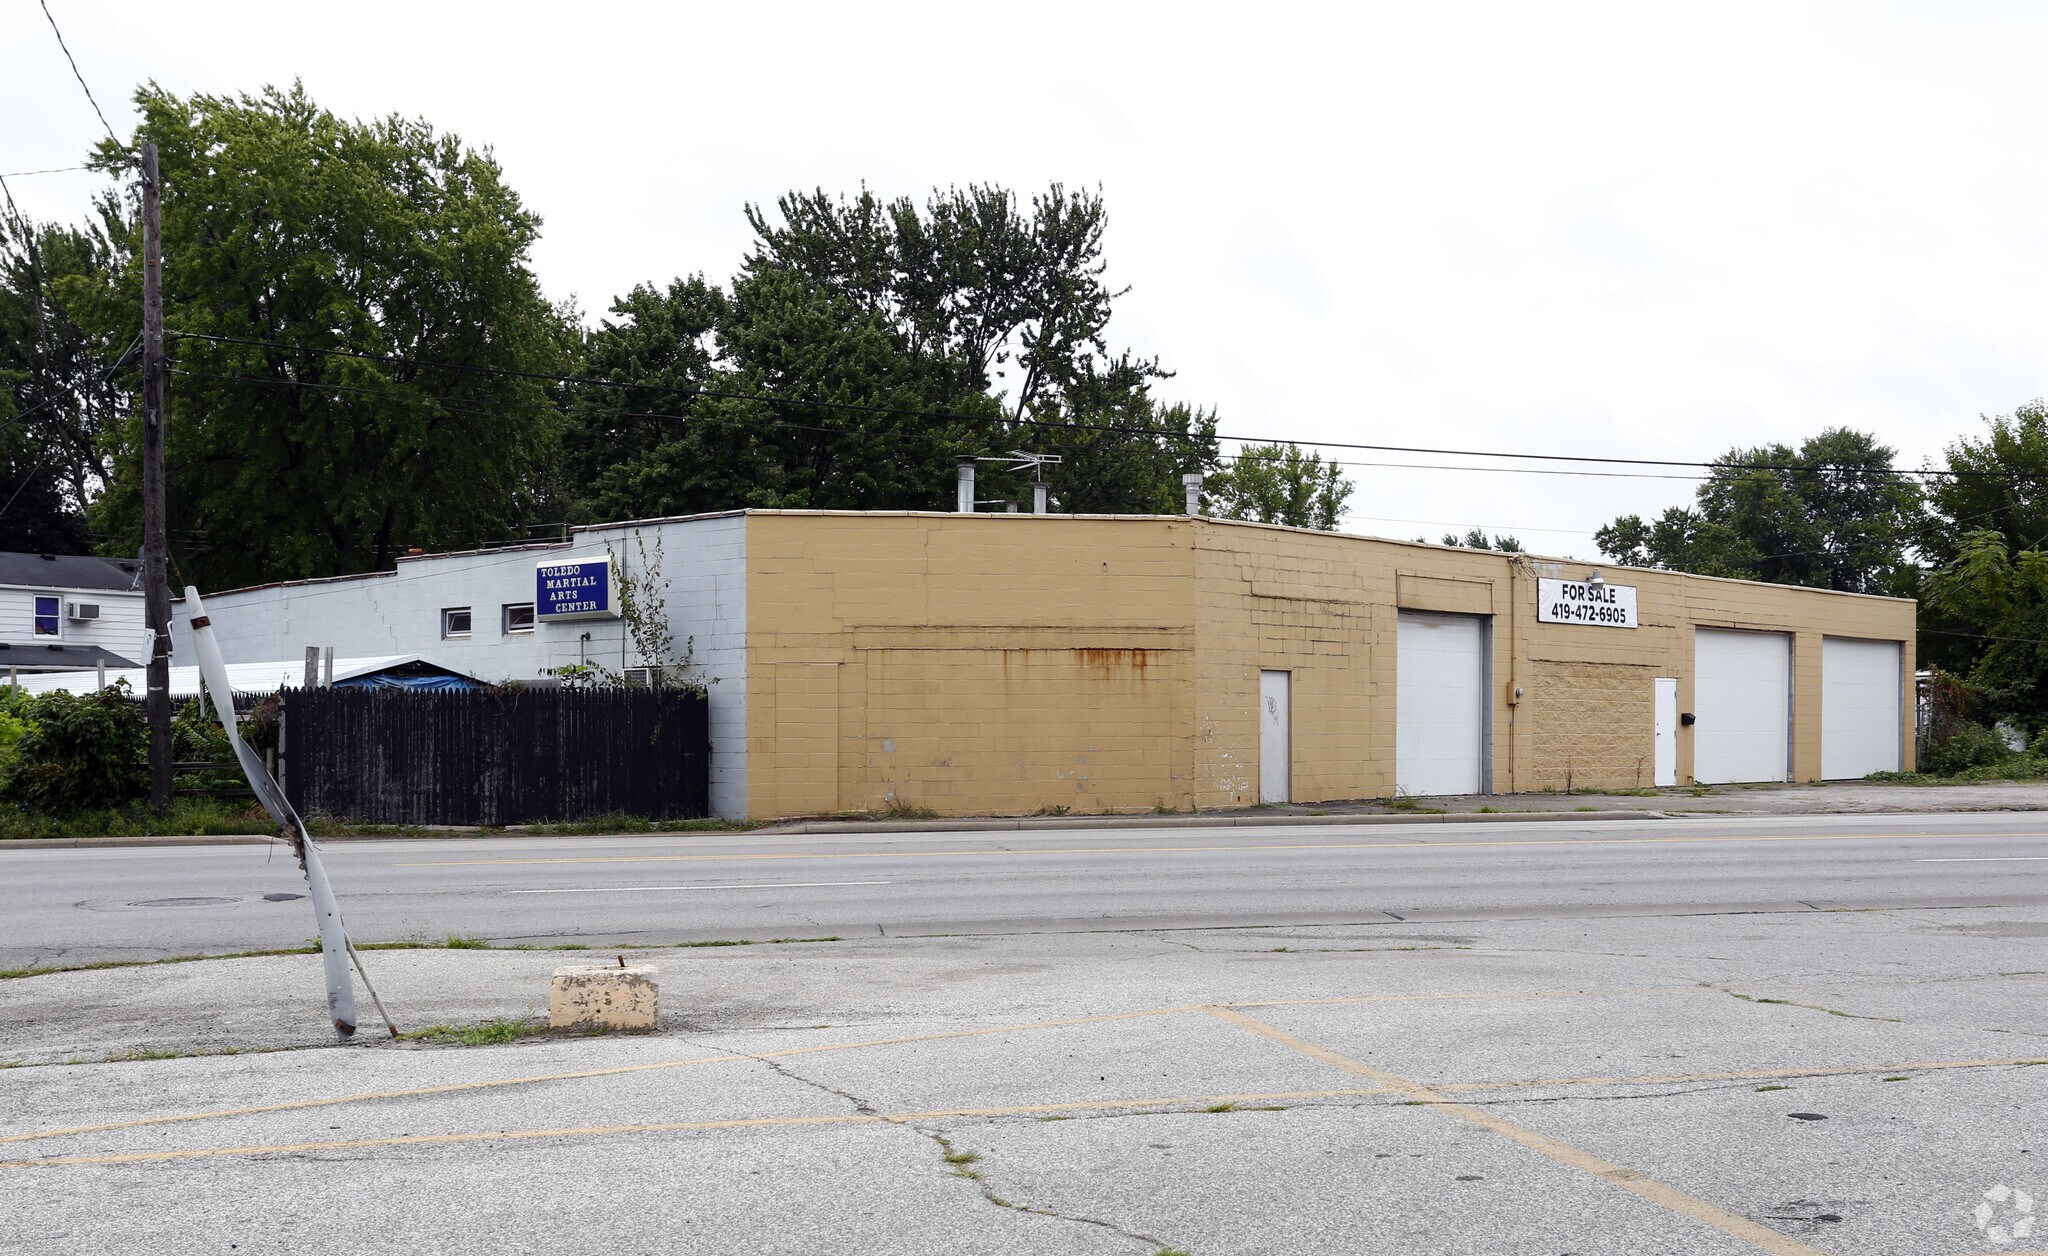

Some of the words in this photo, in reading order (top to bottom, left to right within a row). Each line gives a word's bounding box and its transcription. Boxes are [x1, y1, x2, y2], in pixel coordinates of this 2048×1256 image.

[541, 566, 580, 577] TOLEDO
[546, 576, 596, 588] MARTIAL
[550, 590, 578, 600] ARTS
[1562, 584, 1585, 601] FOR
[1588, 586, 1616, 604] SALE
[556, 601, 597, 612] CENTER
[1552, 602, 1626, 624] 419-472-6905
